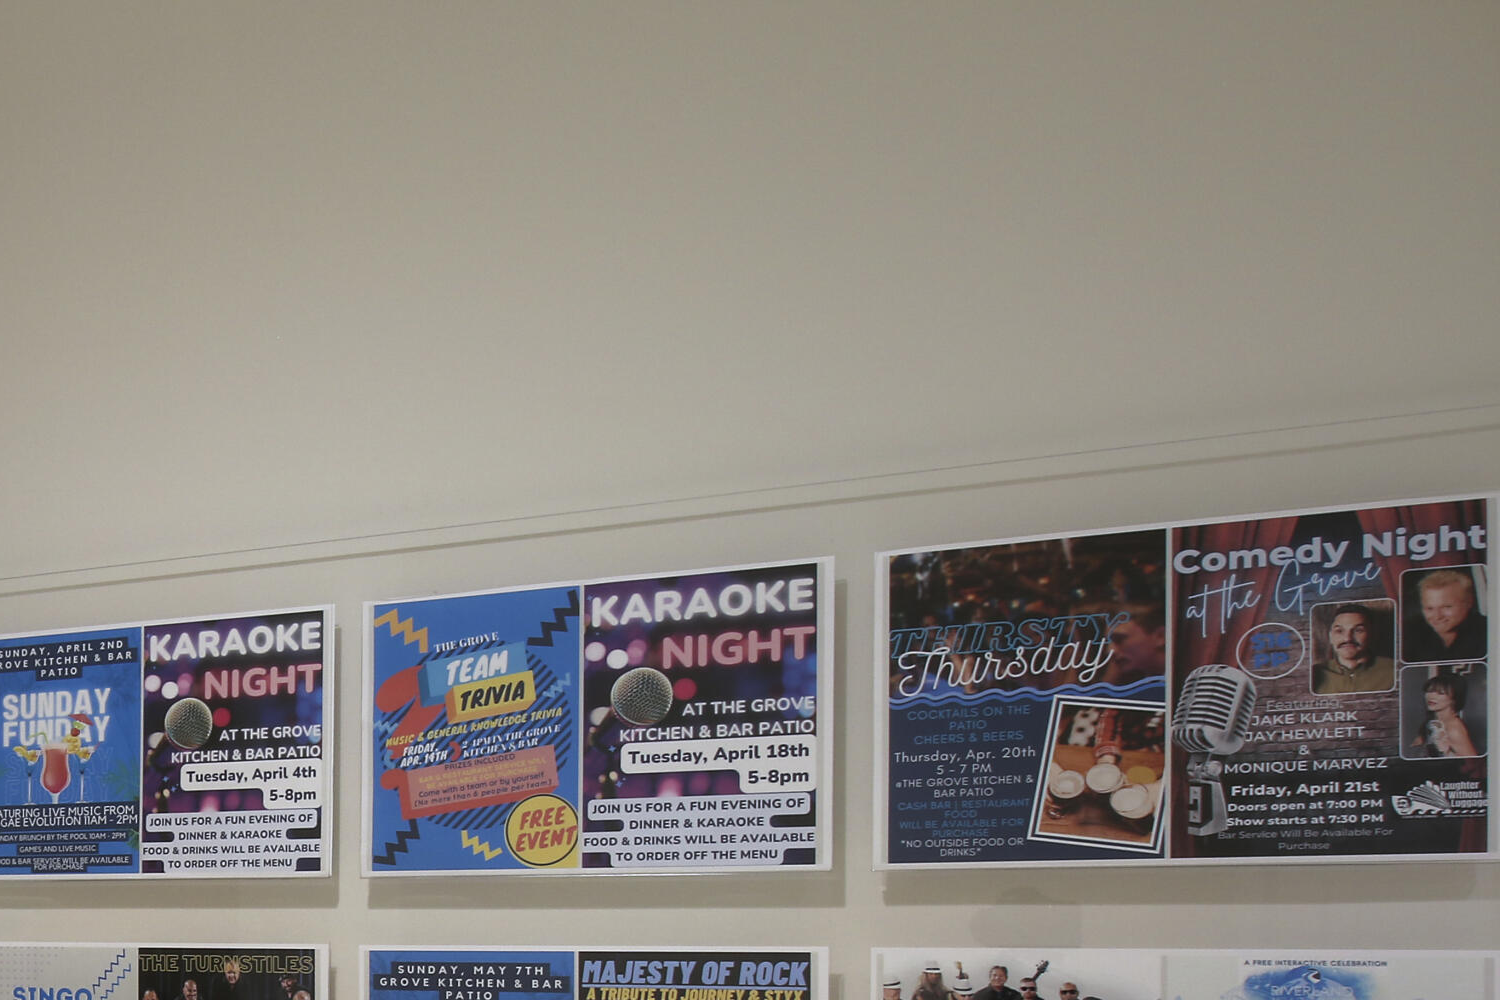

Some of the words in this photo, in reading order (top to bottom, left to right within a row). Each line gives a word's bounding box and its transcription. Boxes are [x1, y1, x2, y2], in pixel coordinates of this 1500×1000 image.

[1173, 536, 1349, 574] Comedy
[1363, 525, 1487, 560] Night
[592, 578, 814, 627] KARAOKE
[150, 621, 321, 662] KARAOKE
[433, 643, 458, 653] THE
[459, 632, 499, 648] GROVE
[890, 611, 1131, 660] THIRSTY
[57, 643, 93, 653] APRIL
[100, 640, 123, 650] 2ND
[662, 626, 815, 669] NIGHT
[35, 655, 87, 667] KITCHEN
[108, 651, 132, 660] BAR
[446, 650, 508, 686] TEAM
[899, 636, 1114, 697] Thursday
[41, 667, 78, 677] PATIO
[205, 664, 322, 700] NIGHT
[3, 688, 111, 720] SUNDAY
[461, 680, 525, 711] TRIVIA
[682, 702, 707, 717] AT
[710, 700, 746, 714] THE
[751, 696, 815, 712] GROVE
[1252, 713, 1295, 727] JAKE
[1301, 711, 1358, 724] KLARK
[3, 716, 110, 747] FUNDAY
[220, 729, 238, 741] AT
[241, 727, 268, 740] THE
[272, 725, 321, 739] GROVE
[620, 726, 693, 742] KITCHEN
[699, 726, 711, 738] &
[717, 723, 753, 738] BAR
[759, 719, 814, 735] PATIO
[1245, 731, 1285, 742] JAY
[1289, 726, 1365, 740] HEWLETT
[171, 750, 228, 763] KITCHEN
[232, 751, 241, 760] &
[246, 748, 274, 759] BAR
[278, 746, 321, 758] PATIO
[628, 749, 707, 764] Tuesday,
[714, 745, 760, 763] April
[767, 743, 809, 759] 18th
[894, 751, 961, 764] Thursday,
[965, 750, 995, 761] Apr.
[1002, 746, 1036, 758] 20th
[1299, 744, 1310, 755] &
[400, 755, 422, 767] APR.
[936, 765, 944, 774] 5
[960, 765, 967, 773] 7
[972, 763, 992, 773] PM
[1225, 760, 1307, 776] MONIQUE
[1313, 757, 1388, 770] MARVEZ
[187, 770, 248, 783] Tuesday,
[252, 767, 288, 781] April
[292, 766, 316, 778] 4th
[748, 769, 809, 786] 5-8pm
[270, 789, 316, 802] 5-8pm
[1231, 783, 1291, 798] Friday,
[1296, 782, 1339, 798] April
[1345, 781, 1380, 793] 21st
[43, 807, 65, 817] LIVE
[68, 806, 100, 816] MUSIC
[104, 805, 134, 815] FROM
[520, 806, 566, 831] FREE
[516, 825, 577, 852] EVENT
[139, 954, 178, 972] THE
[182, 955, 313, 974] TURNSTILES
[397, 966, 465, 975] SUNDAY,
[474, 966, 506, 975] MAY
[515, 967, 544, 975] 7TH
[582, 960, 696, 984] MAJESTY
[701, 961, 734, 984] OF
[739, 961, 808, 986] ROCK
[380, 977, 429, 987] GROVE
[438, 979, 505, 988] KITCHEN
[515, 980, 522, 988] &
[532, 980, 563, 989] BAR
[446, 991, 493, 1000] PATIO
[587, 988, 596, 1000] A
[600, 988, 655, 1000] TRIBUTE
[660, 988, 676, 1000] TO
